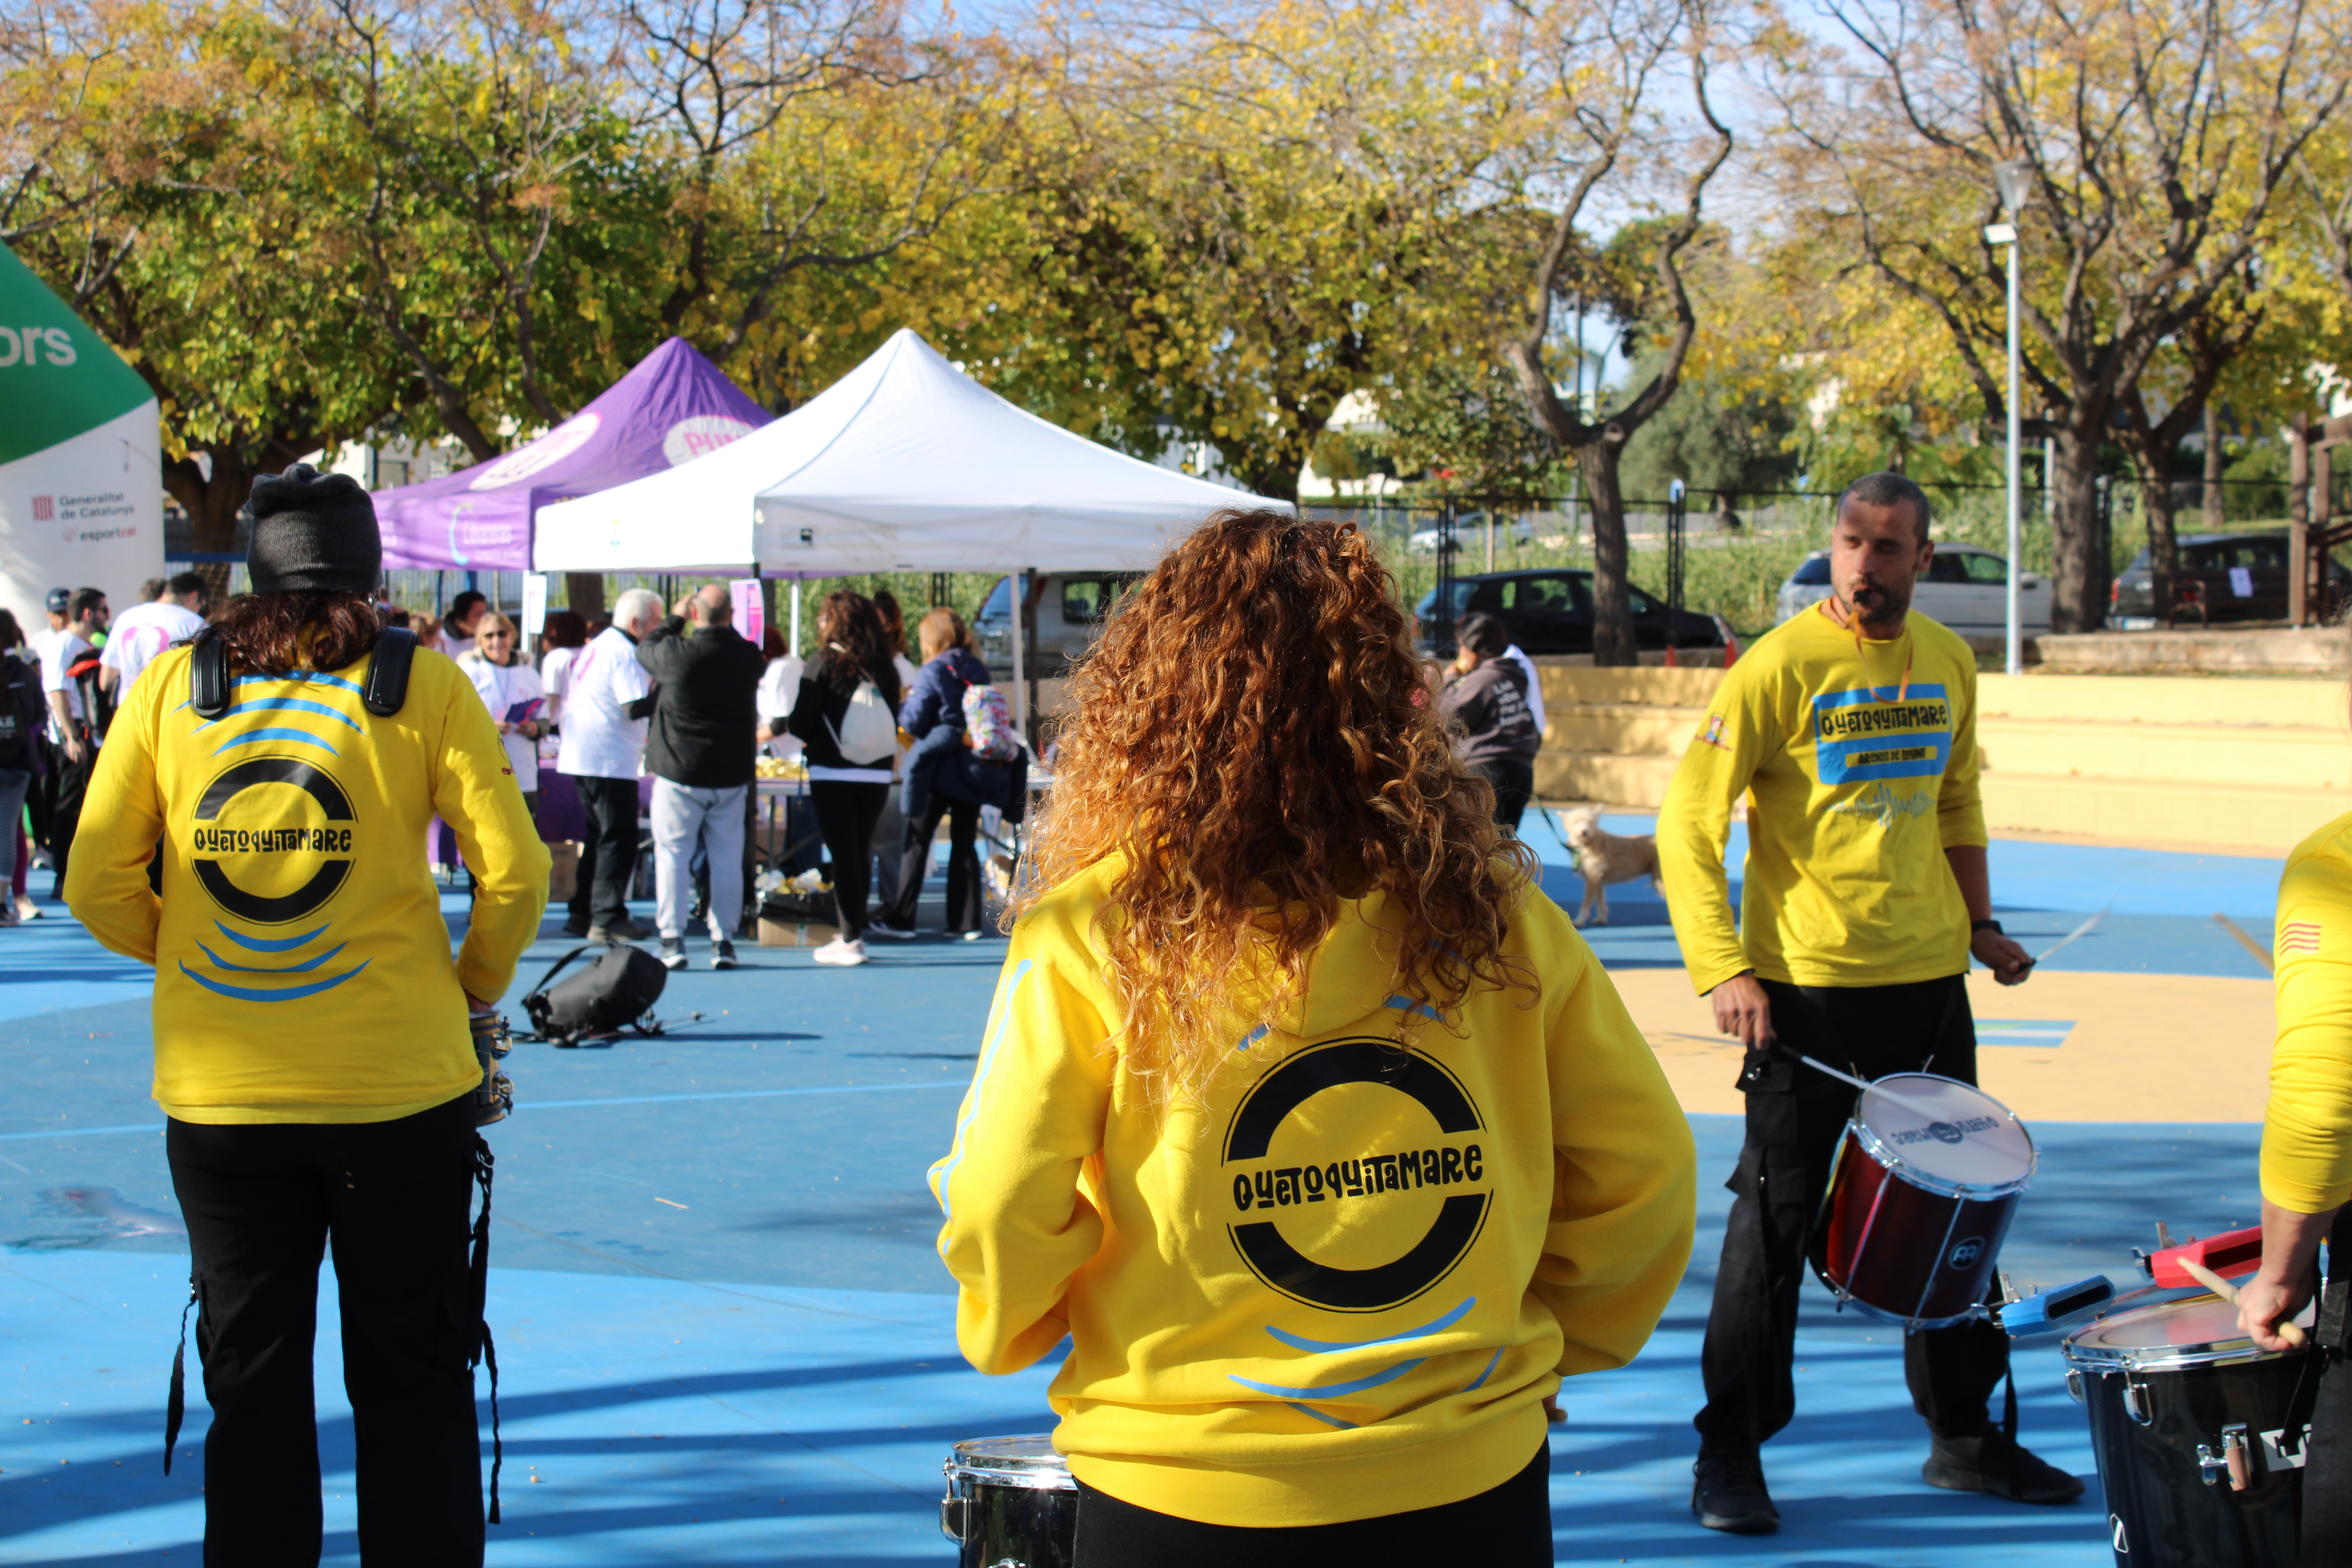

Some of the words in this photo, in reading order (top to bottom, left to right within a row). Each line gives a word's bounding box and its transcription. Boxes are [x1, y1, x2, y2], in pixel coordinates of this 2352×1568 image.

[60, 492, 124, 506] Generalitat
[60, 510, 76, 520] de
[80, 505, 135, 518] Catalunya
